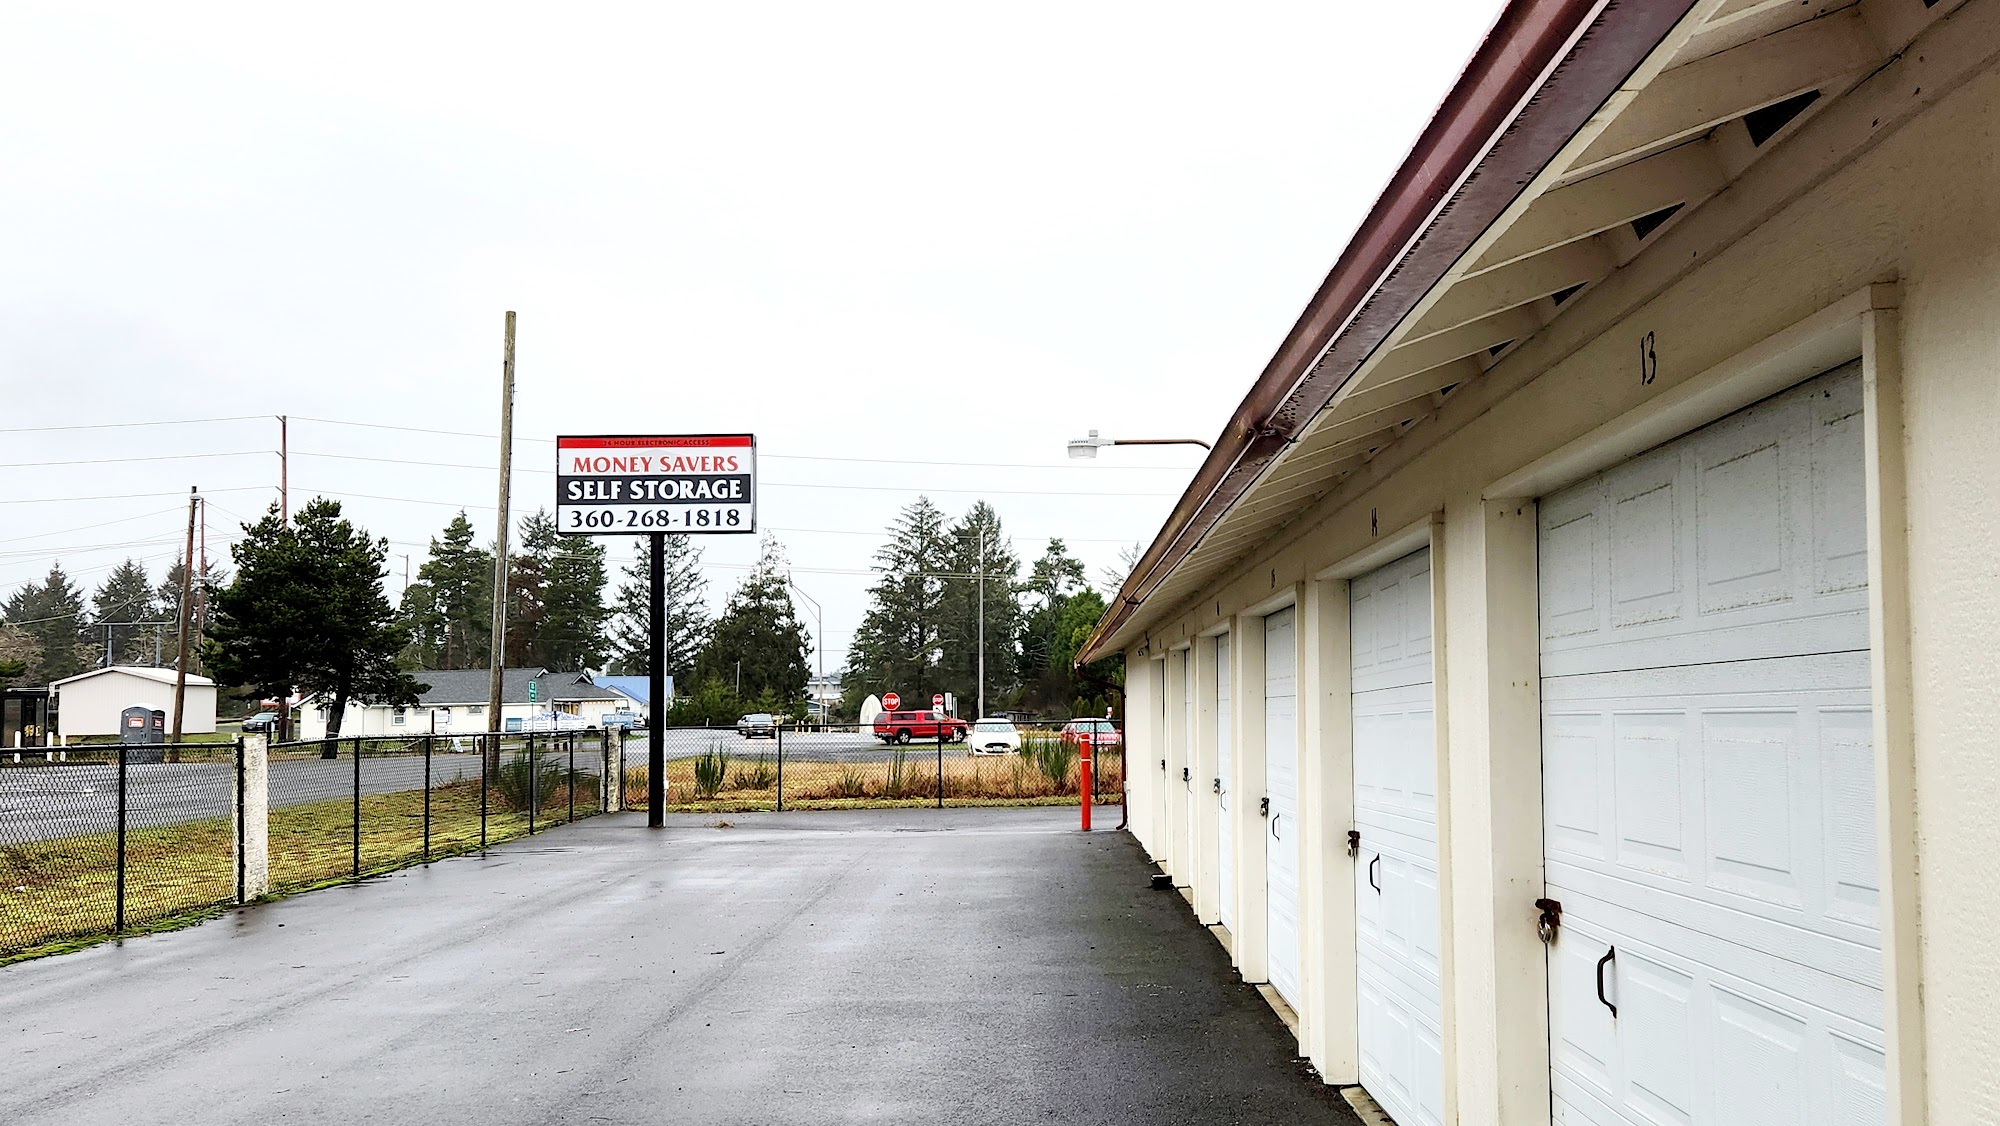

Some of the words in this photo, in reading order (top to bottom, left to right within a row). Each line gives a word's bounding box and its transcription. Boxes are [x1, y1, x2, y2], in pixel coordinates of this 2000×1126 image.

[1640, 330, 1656, 386] 13
[573, 456, 653, 473] MONEY
[659, 455, 739, 472] SAVERS
[567, 480, 623, 500] SELF
[629, 479, 743, 499] STORAGE
[570, 510, 740, 528] 360-268-1818
